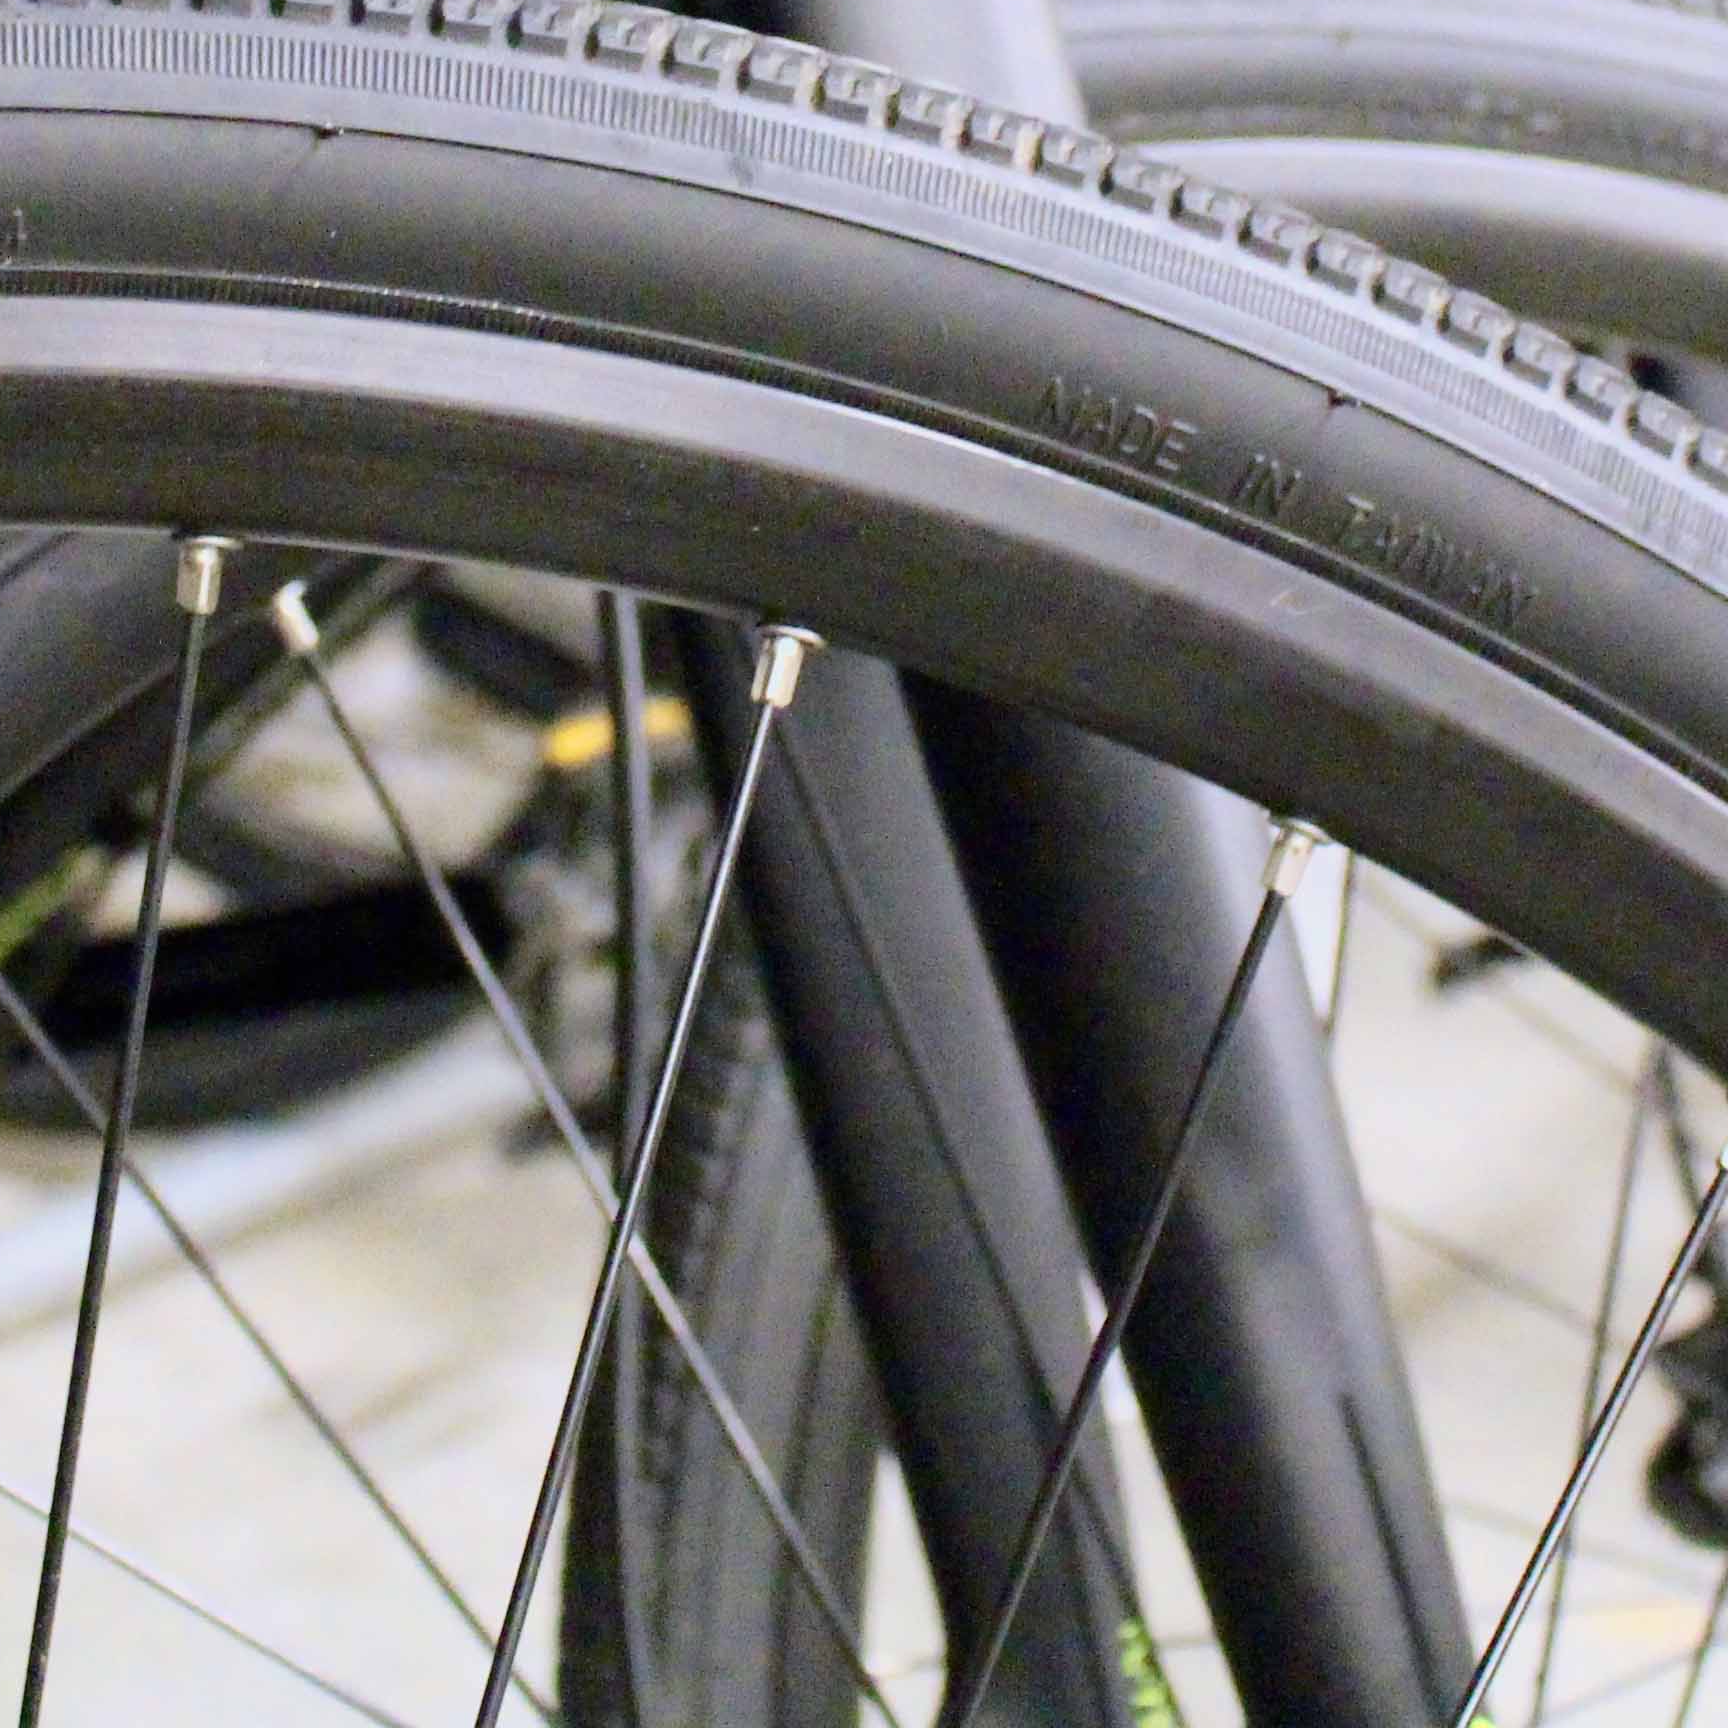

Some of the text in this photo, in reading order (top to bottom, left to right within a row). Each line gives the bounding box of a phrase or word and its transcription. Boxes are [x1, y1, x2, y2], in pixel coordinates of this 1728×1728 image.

[1035, 374, 1542, 625] MADE IN TAIWAN
